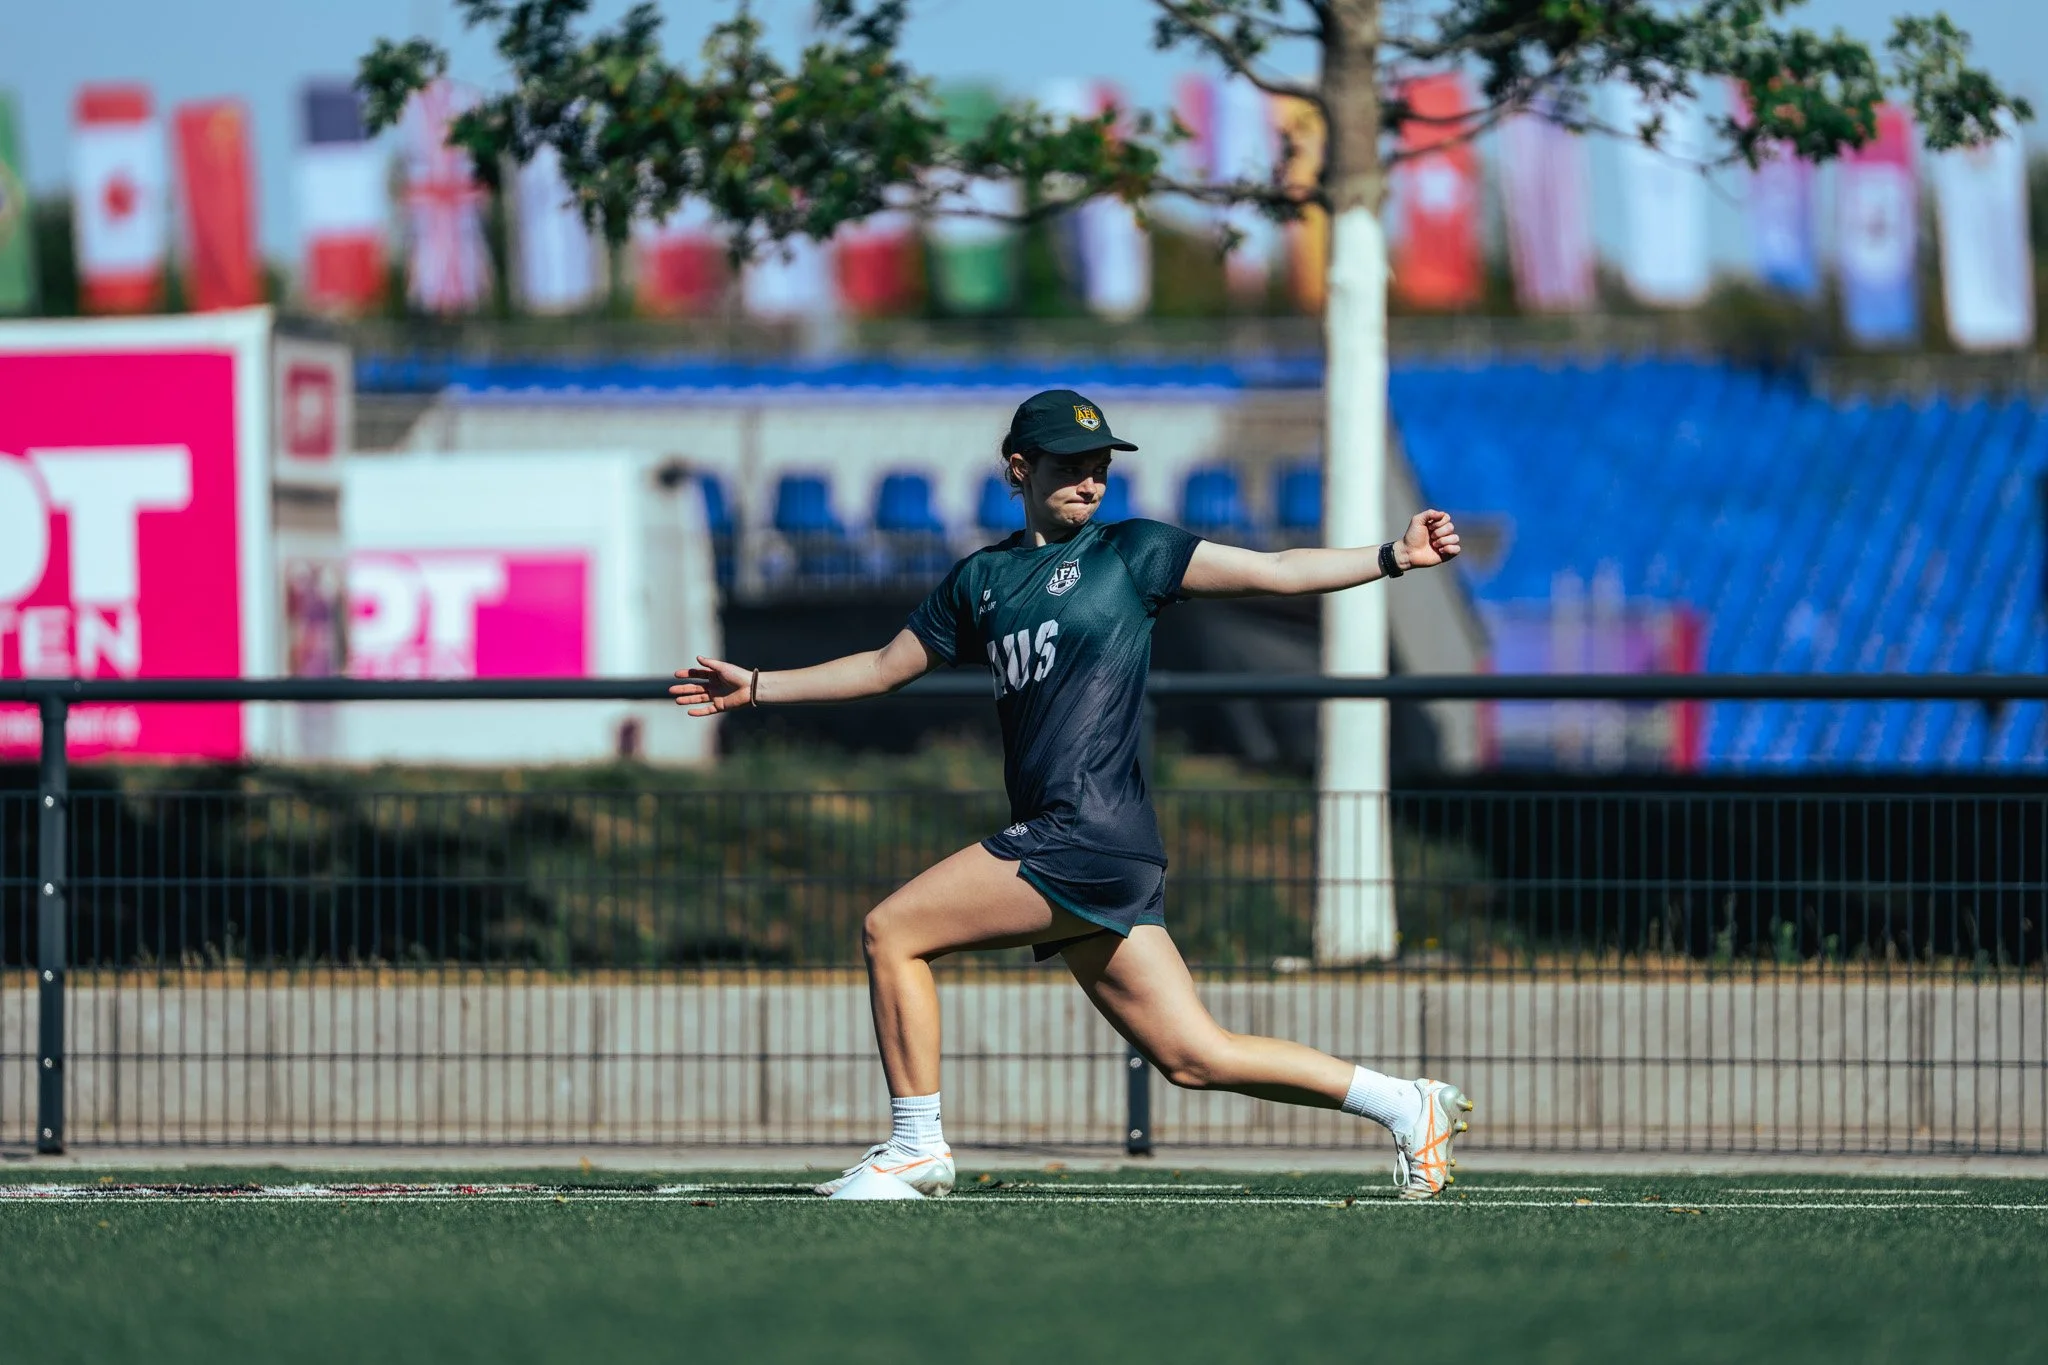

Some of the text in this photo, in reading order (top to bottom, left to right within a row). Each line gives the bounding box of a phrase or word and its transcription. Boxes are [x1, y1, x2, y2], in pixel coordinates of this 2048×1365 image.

[1077, 409, 1100, 420] AFA
[1050, 566, 1079, 584] AFA
[986, 619, 1059, 701] AUS
